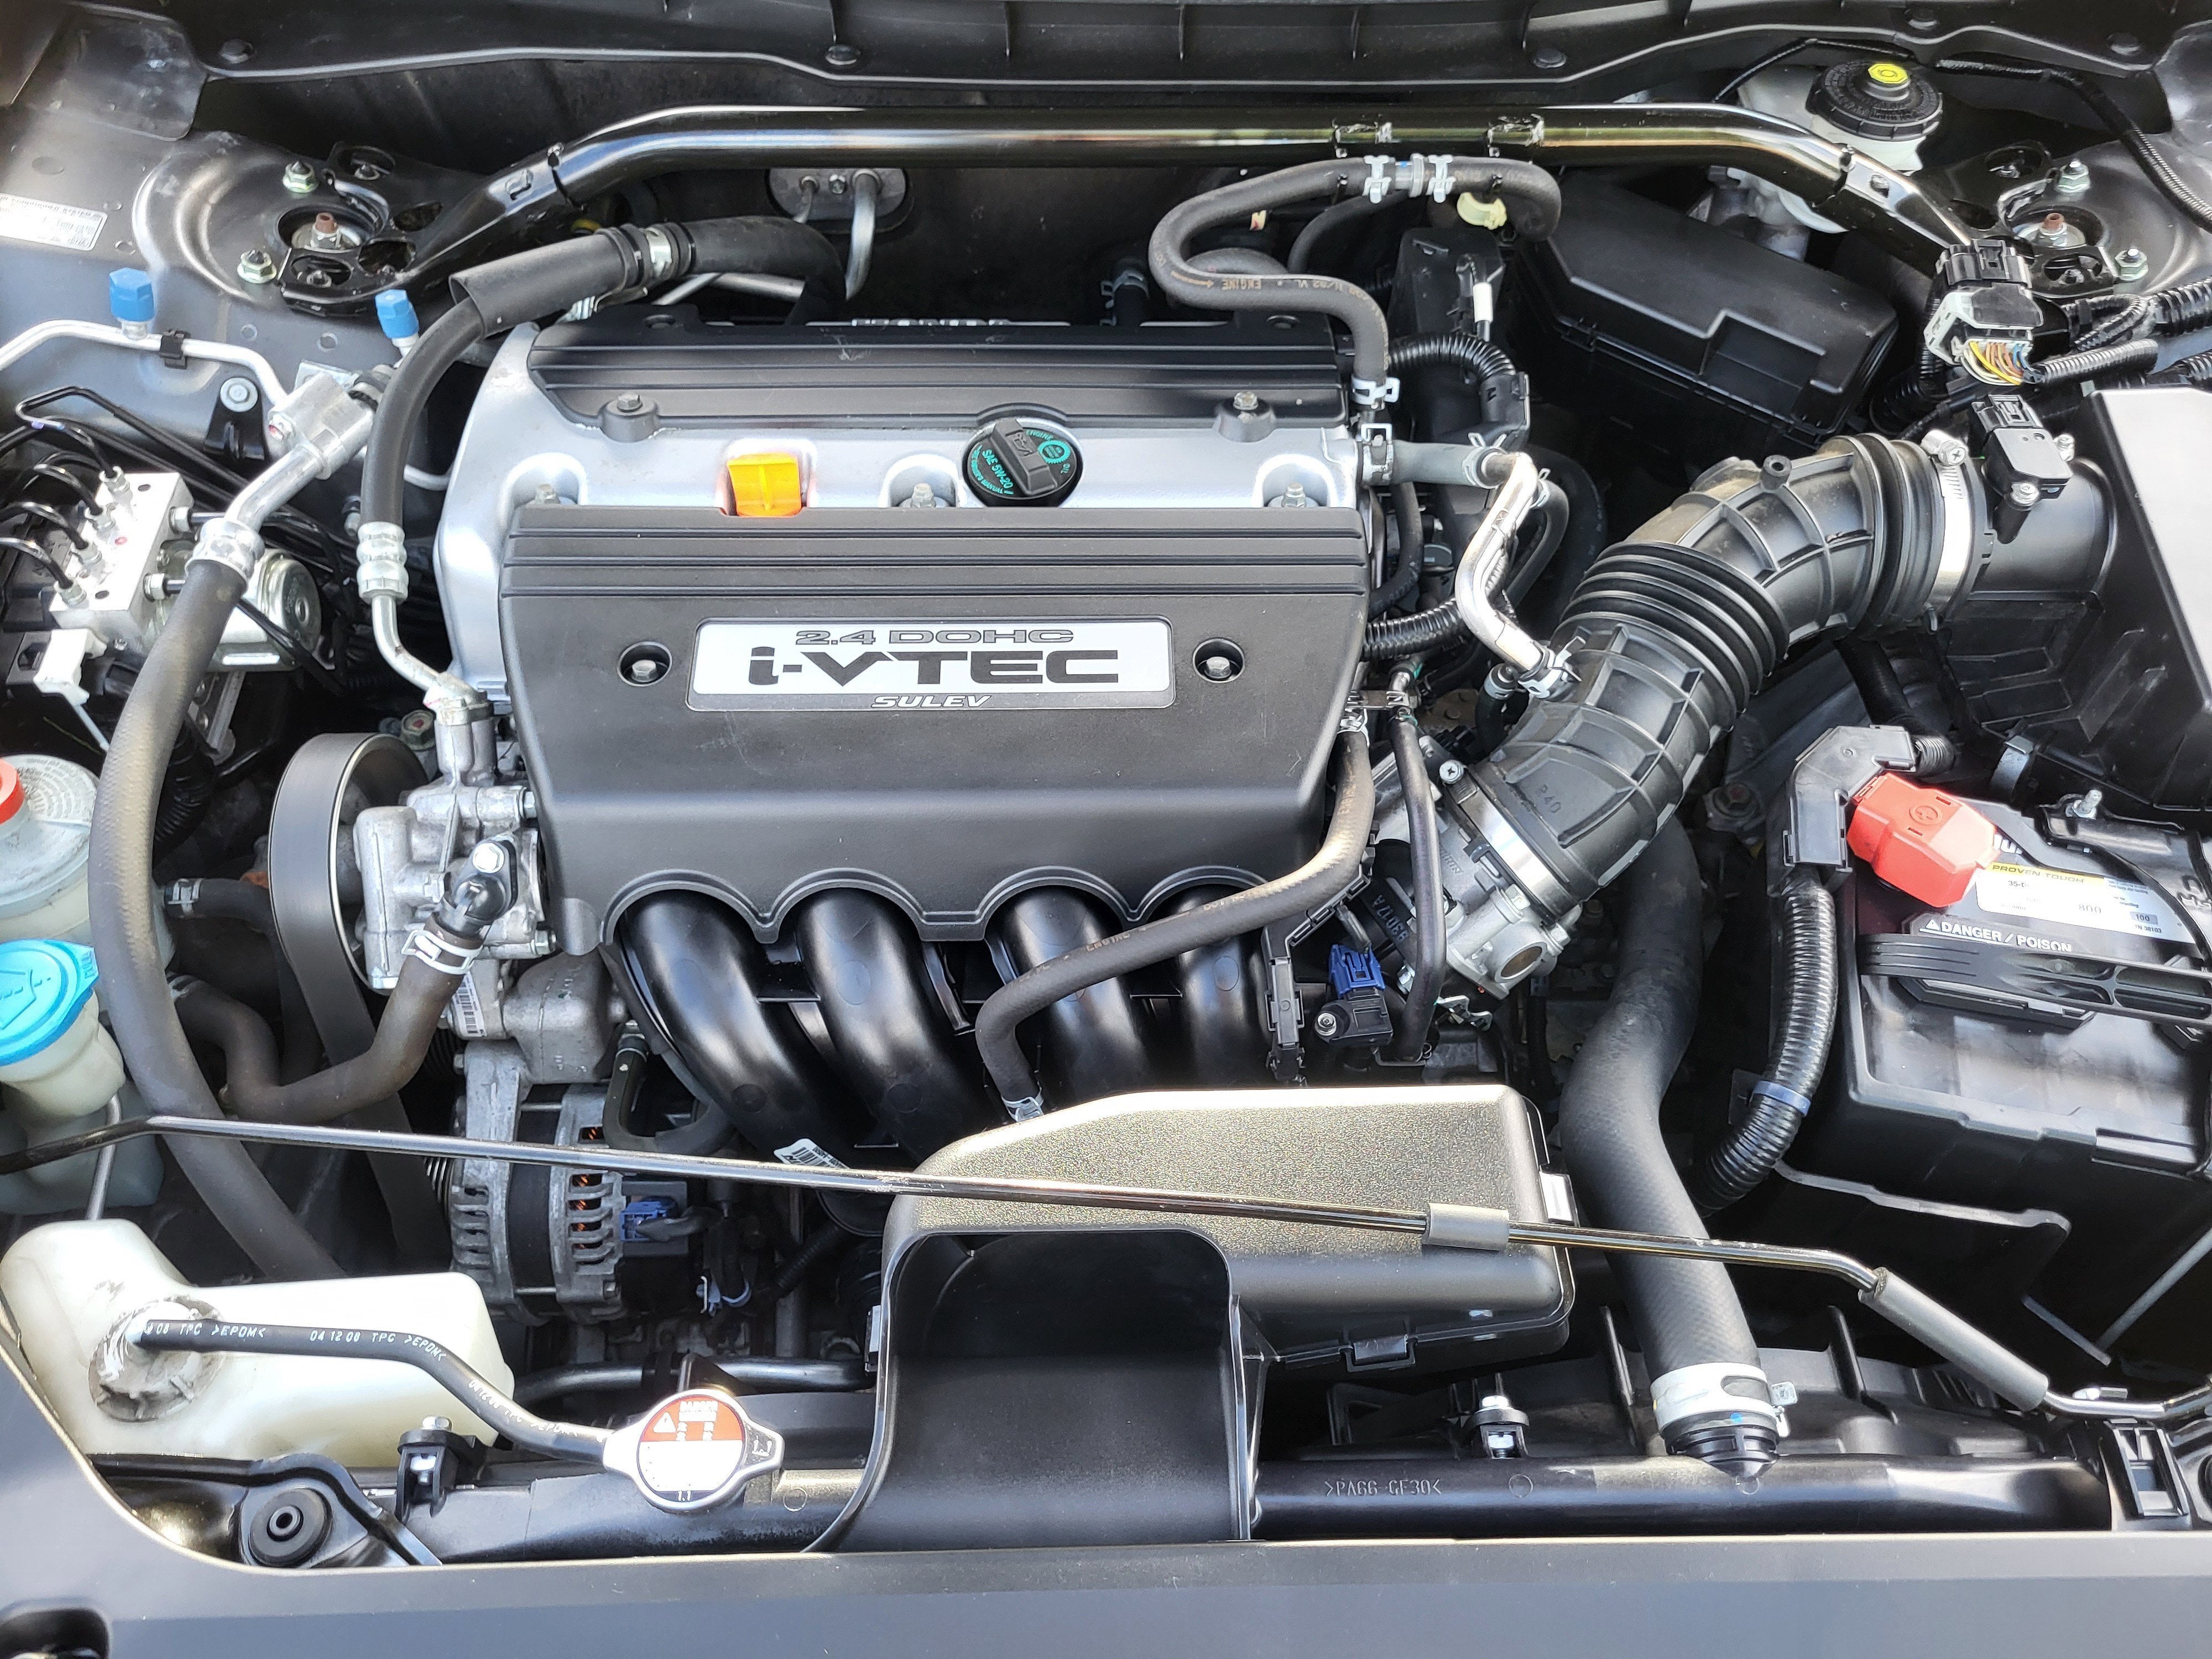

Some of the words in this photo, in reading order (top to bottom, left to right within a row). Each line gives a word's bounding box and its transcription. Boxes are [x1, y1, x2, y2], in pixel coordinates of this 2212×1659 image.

[982, 449, 998, 466] SAE
[991, 463, 1014, 489] 5W-20
[795, 630, 877, 645] 2.4
[889, 629, 1074, 644] DOHC
[748, 646, 1119, 687] i-VTEC
[870, 695, 992, 708] SULEV
[1992, 864, 2041, 877] PROVEN
[2045, 872, 2084, 884] TOUGH
[2079, 904, 2101, 914] 800
[2136, 914, 2150, 922] 100
[1941, 921, 2001, 941] DANGER
[2016, 934, 2072, 952] POISON
[180, 1322, 203, 1336] TPC
[310, 1329, 326, 1342] 04
[330, 1331, 343, 1342] 12
[371, 1332, 397, 1343] TPC
